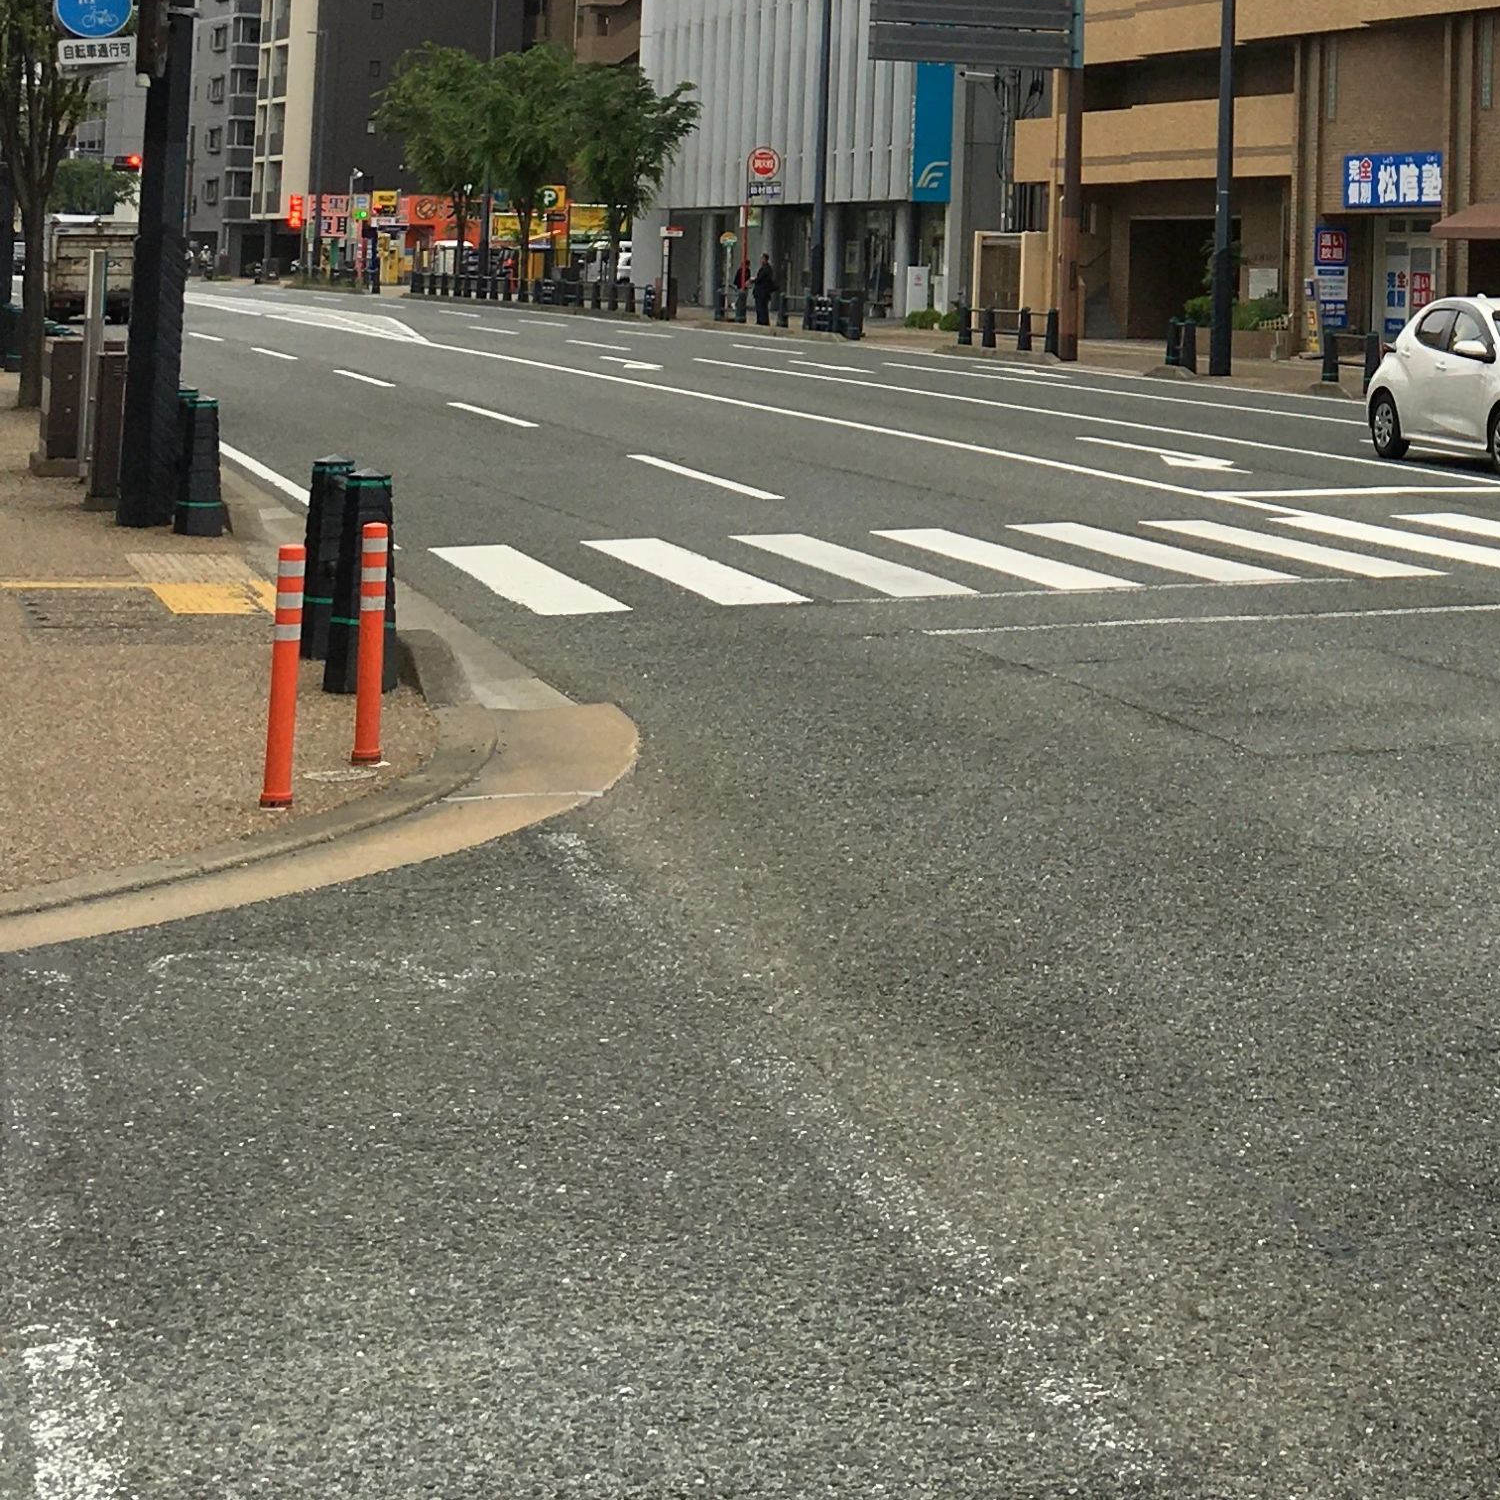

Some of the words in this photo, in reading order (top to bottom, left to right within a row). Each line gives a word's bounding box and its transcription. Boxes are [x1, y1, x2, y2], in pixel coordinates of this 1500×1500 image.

[63, 42, 131, 60] 自転車通行可
